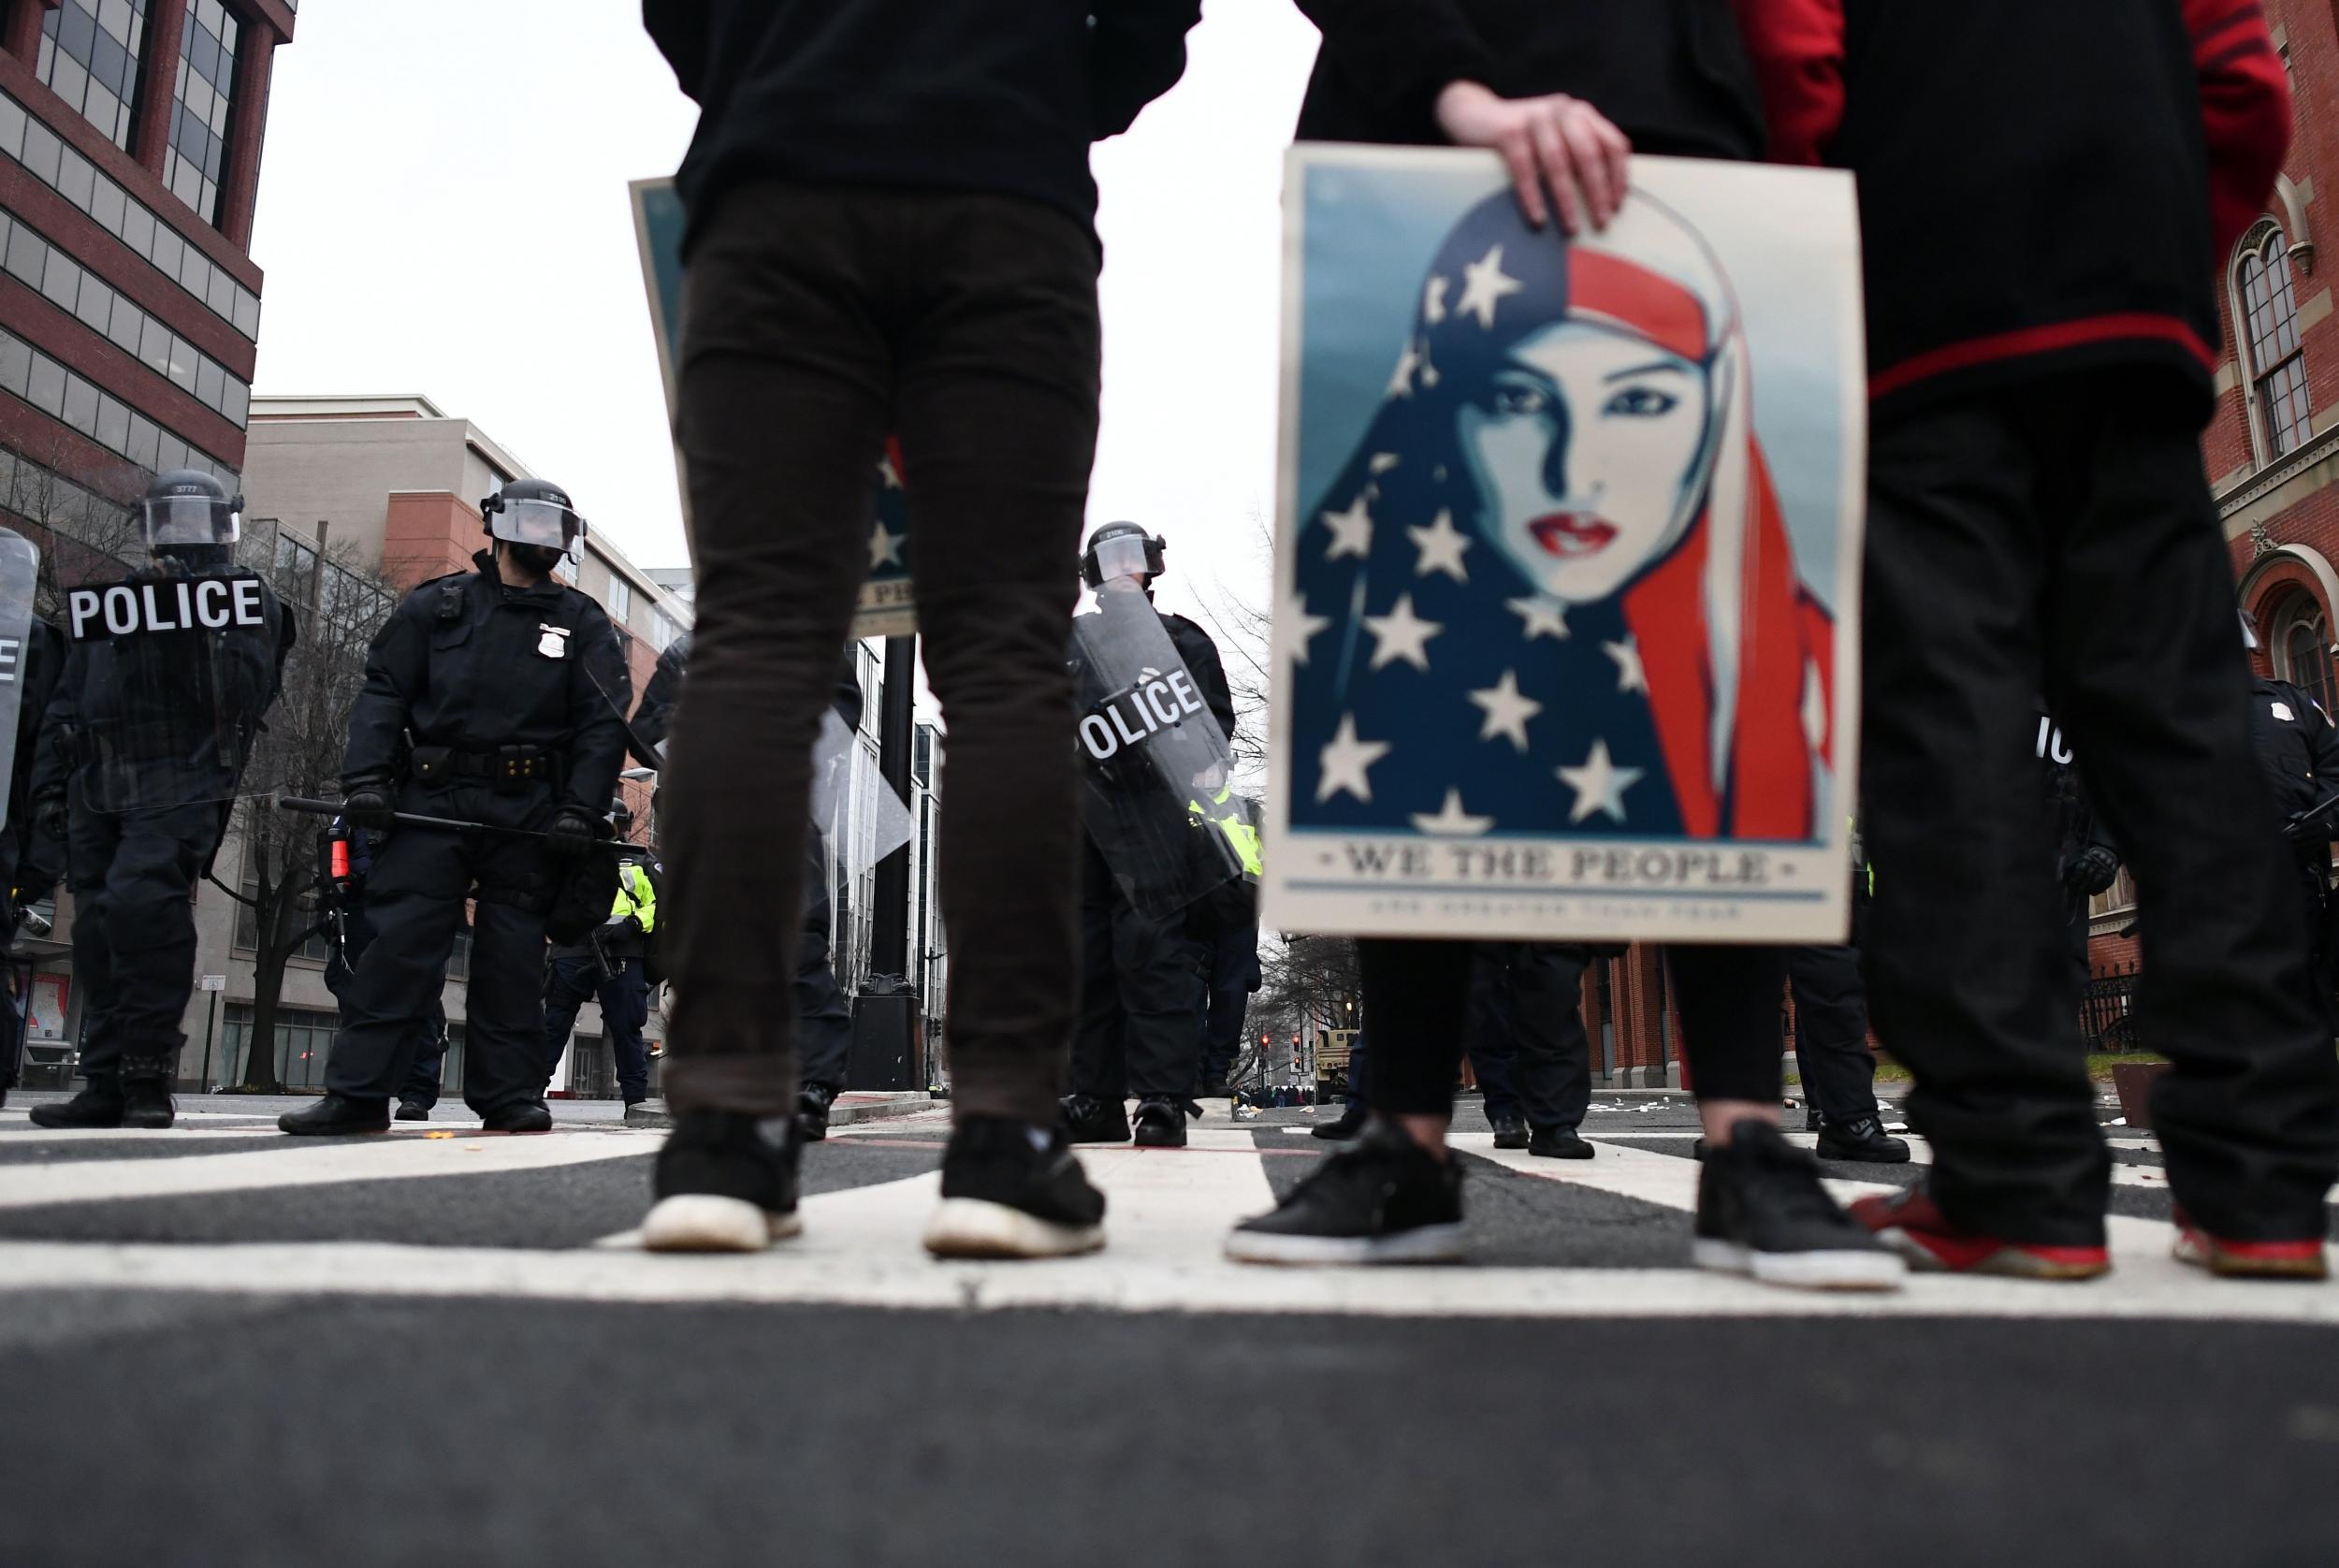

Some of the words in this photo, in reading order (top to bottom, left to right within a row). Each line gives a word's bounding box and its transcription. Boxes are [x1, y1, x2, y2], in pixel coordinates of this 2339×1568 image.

[69, 579, 264, 638] POLICE
[1075, 669, 1202, 760] OLICE
[1344, 842, 1431, 875] WE
[1451, 845, 1553, 879] THE
[1571, 849, 1769, 884] PEOPLE
